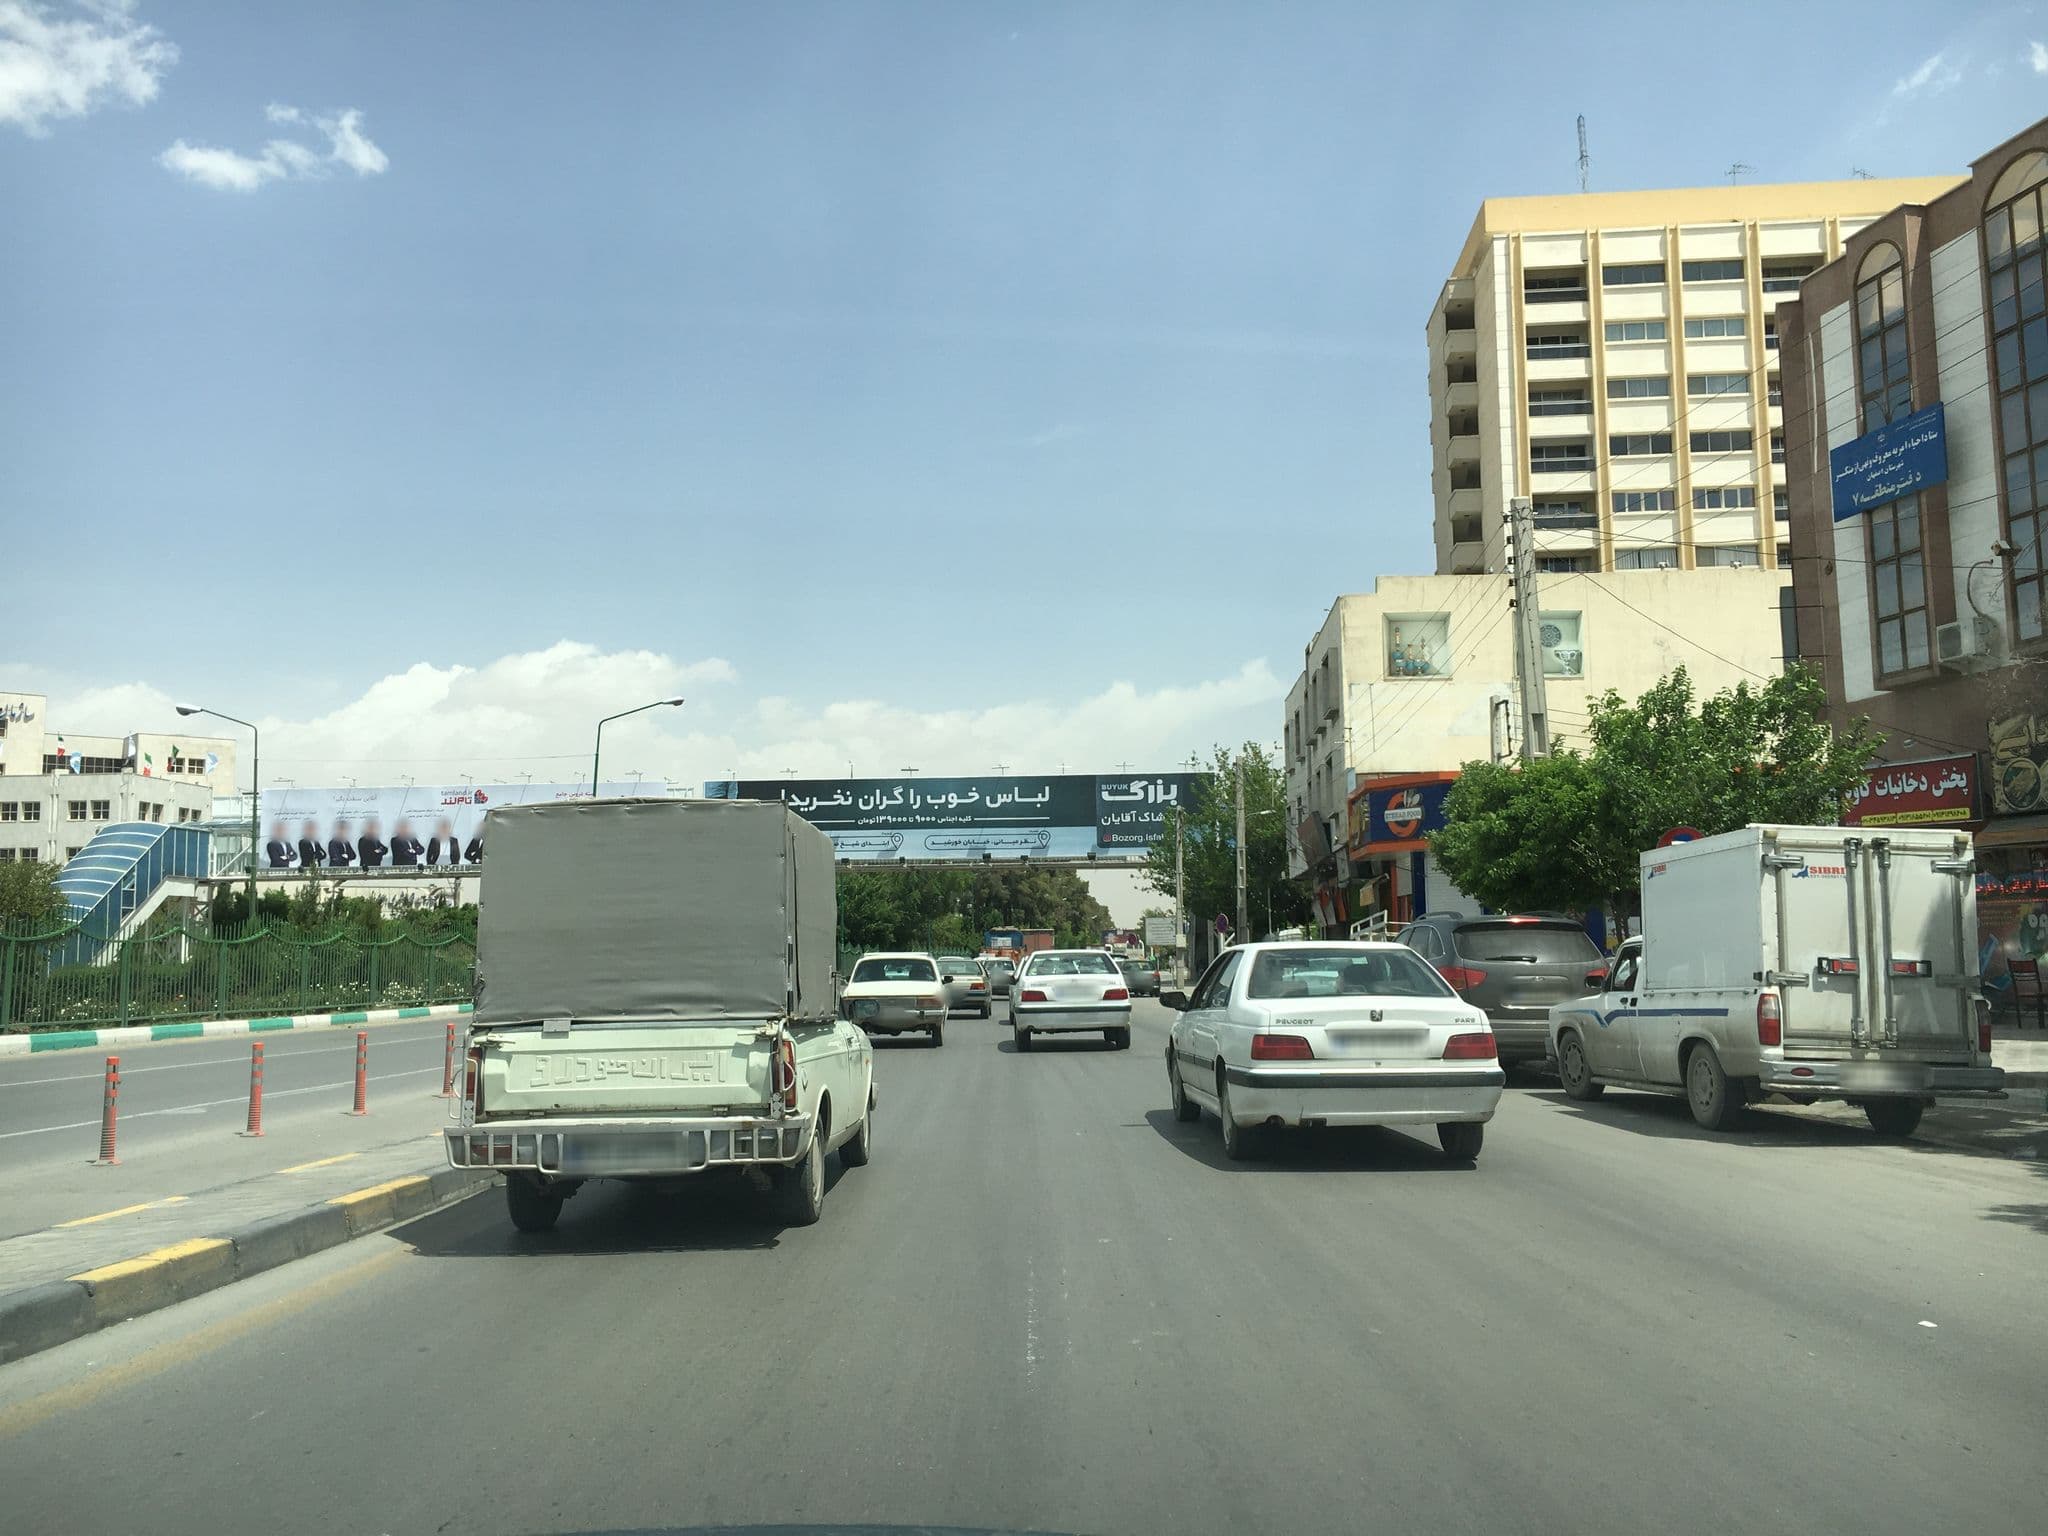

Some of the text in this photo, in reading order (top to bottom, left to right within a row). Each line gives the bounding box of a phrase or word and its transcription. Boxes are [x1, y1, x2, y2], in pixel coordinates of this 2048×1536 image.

[1860, 481, 1896, 502] منطقه
[1895, 469, 1921, 495] دفتر
[1101, 779, 1178, 806] بزرگ
[1875, 772, 1928, 799] دخانیات
[1932, 767, 1968, 797] پخش
[858, 786, 904, 810] گران
[909, 788, 921, 809] را
[926, 787, 980, 810] خوب
[985, 786, 1050, 808] لباس
[937, 816, 957, 824] اجناس
[958, 815, 972, 823] کلیه
[1101, 810, 1137, 825] آقایان
[840, 840, 860, 849] شیخ
[861, 840, 890, 848] ابتدای
[931, 839, 962, 847] خورشید
[963, 838, 990, 846] خیابان
[1809, 866, 1845, 874] SIBRI
[530, 1050, 726, 1088] ایران خودرو
